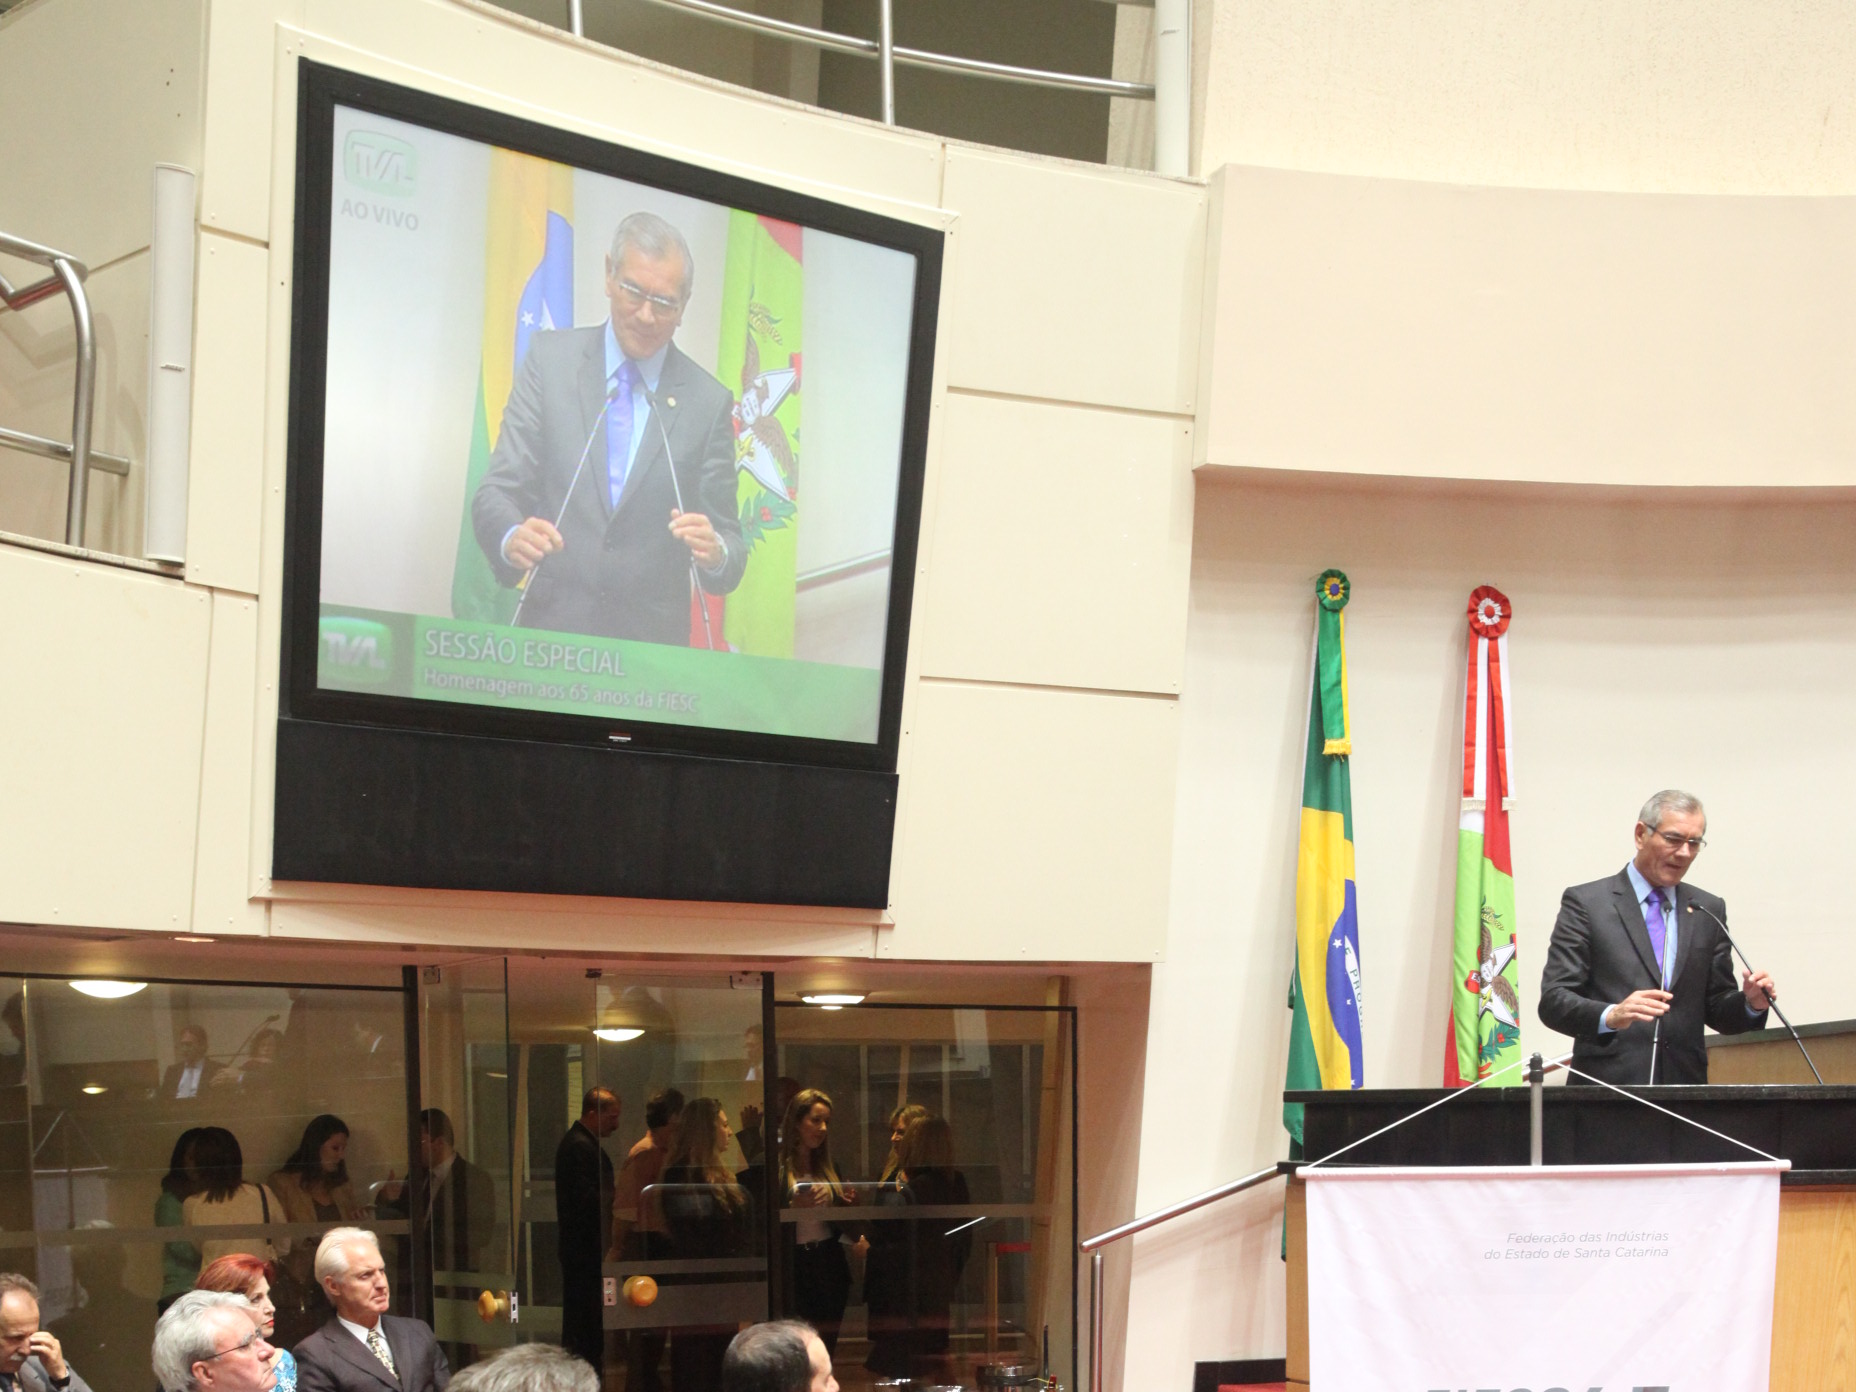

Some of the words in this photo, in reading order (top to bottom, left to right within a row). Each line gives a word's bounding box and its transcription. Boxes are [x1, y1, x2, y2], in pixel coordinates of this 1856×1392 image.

[340, 199, 368, 219] AO
[373, 204, 419, 231] VIVO
[425, 629, 517, 665] SESSÃO
[523, 640, 626, 677] ESPECIAL
[424, 668, 534, 698] Homenagem
[538, 683, 566, 700] aos
[570, 683, 590, 702] 65
[593, 689, 631, 707] anos
[634, 690, 652, 708] da
[657, 691, 699, 713] FIESC
[1484, 1248, 1501, 1260] do
[1505, 1248, 1550, 1260] Estado
[1553, 1247, 1570, 1259] de
[1574, 1247, 1610, 1259] Santa
[1615, 1246, 1669, 1258] Catarina
[1506, 1232, 1575, 1245] Federação
[1579, 1231, 1602, 1243] das
[1606, 1230, 1670, 1243] Indústrias
